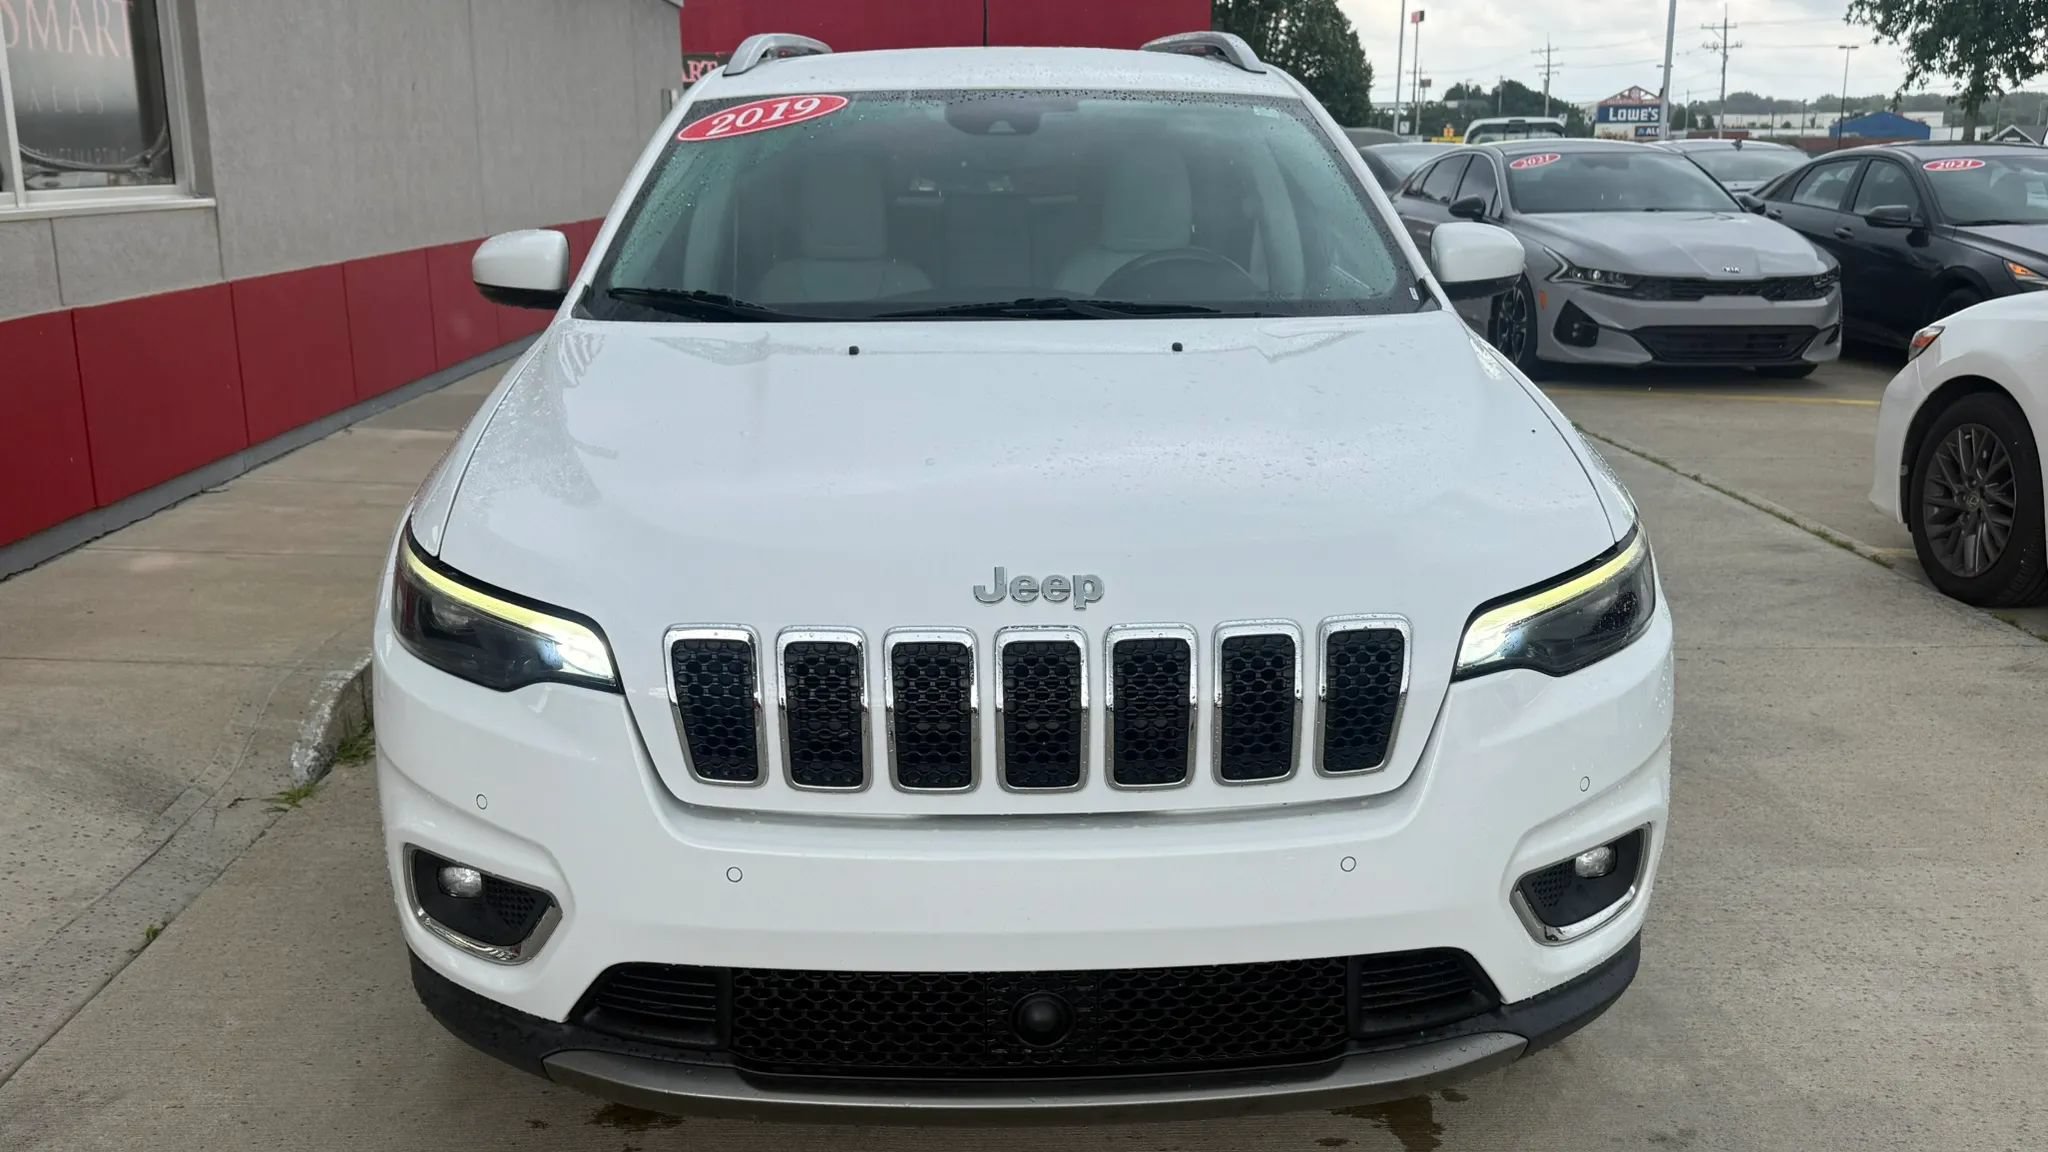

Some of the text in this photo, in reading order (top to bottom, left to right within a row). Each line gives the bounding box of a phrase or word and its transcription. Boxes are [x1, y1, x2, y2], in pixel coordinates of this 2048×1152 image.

[705, 97, 822, 137] 2019
[1608, 107, 1659, 121] LOWE'S
[1520, 154, 1550, 169] 2021
[1935, 160, 1973, 170] 2021
[972, 566, 1105, 611] Jeep
